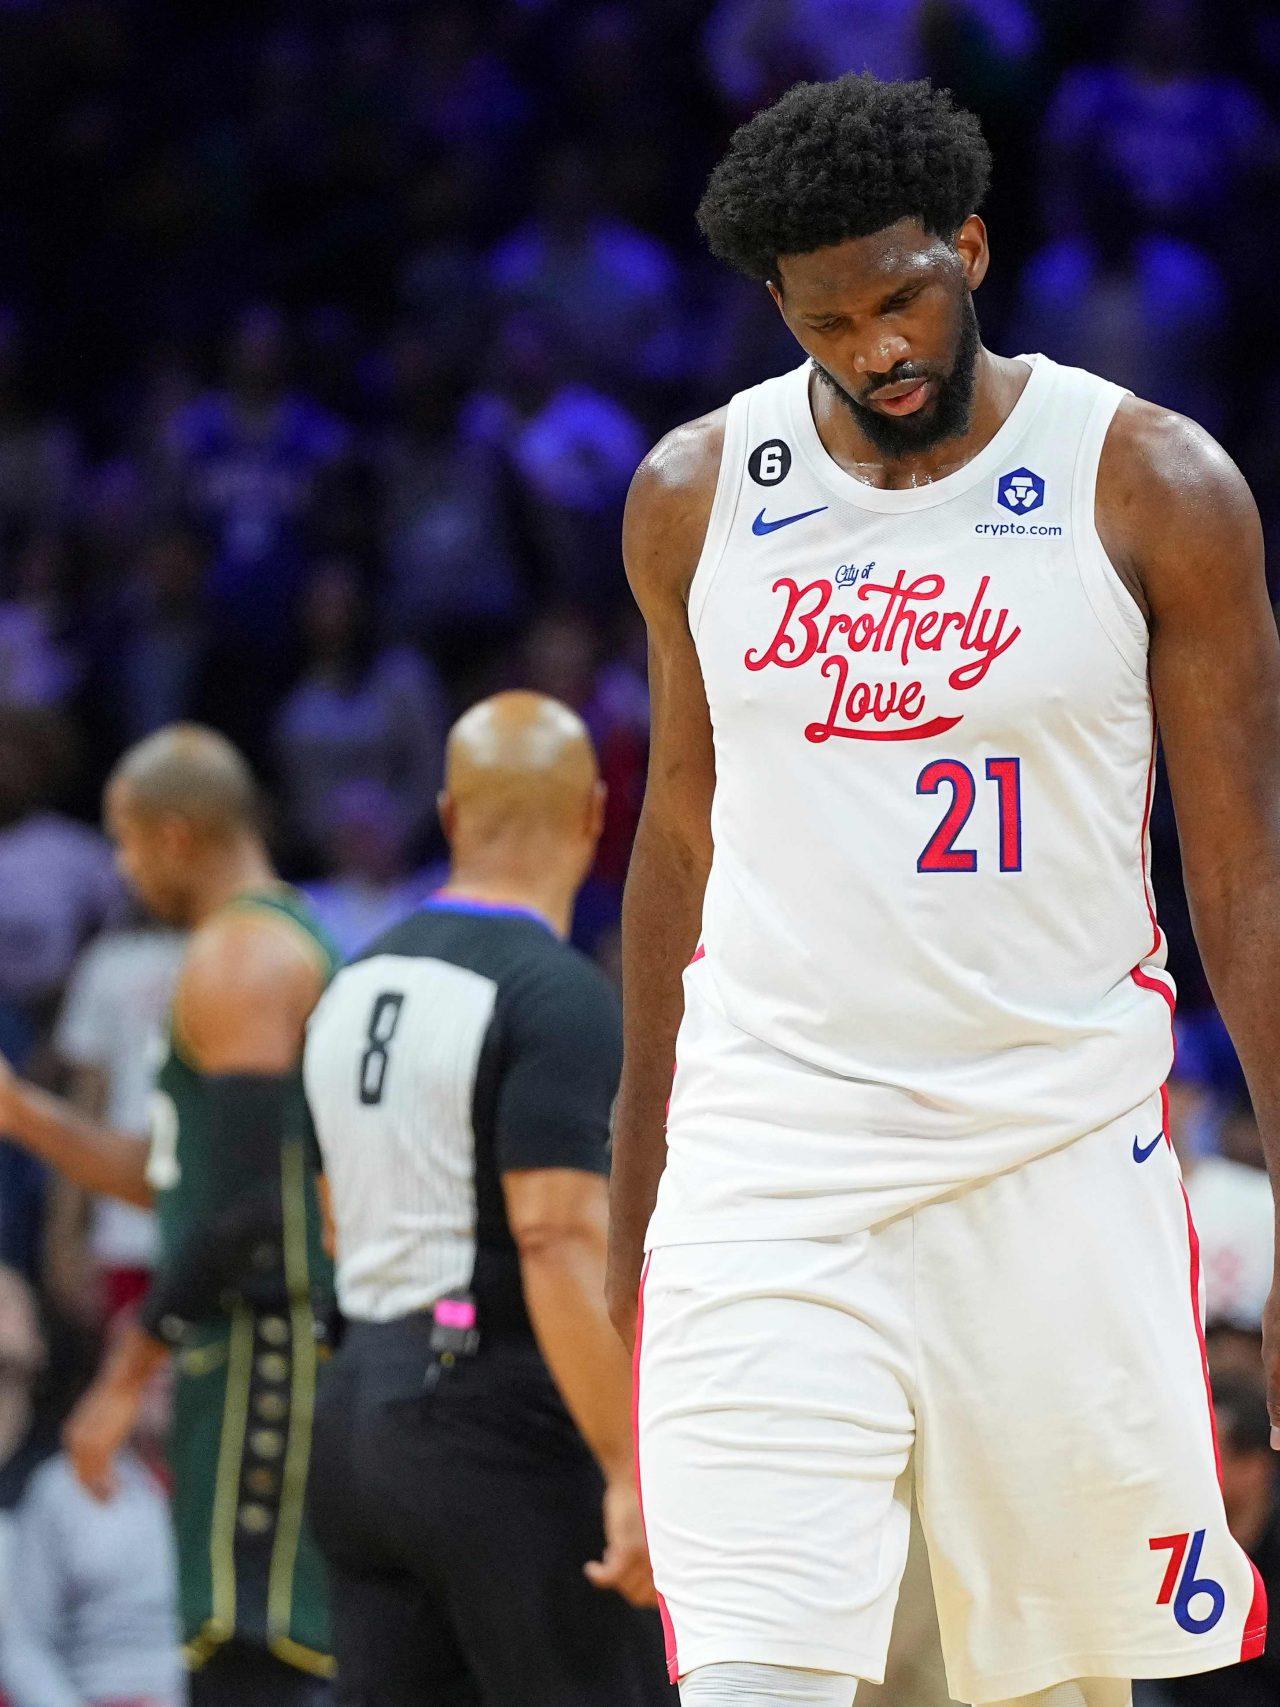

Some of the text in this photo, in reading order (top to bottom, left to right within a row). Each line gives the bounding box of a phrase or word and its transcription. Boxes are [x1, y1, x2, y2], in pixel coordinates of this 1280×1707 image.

[760, 446, 783, 481] 6
[835, 562, 875, 590] City of
[975, 522, 1062, 537] crypto.com
[744, 570, 1021, 690] Brotherly
[805, 655, 964, 743] Love
[916, 757, 1022, 873] 21
[361, 993, 404, 1105] 8
[1149, 1529, 1225, 1634] 76
